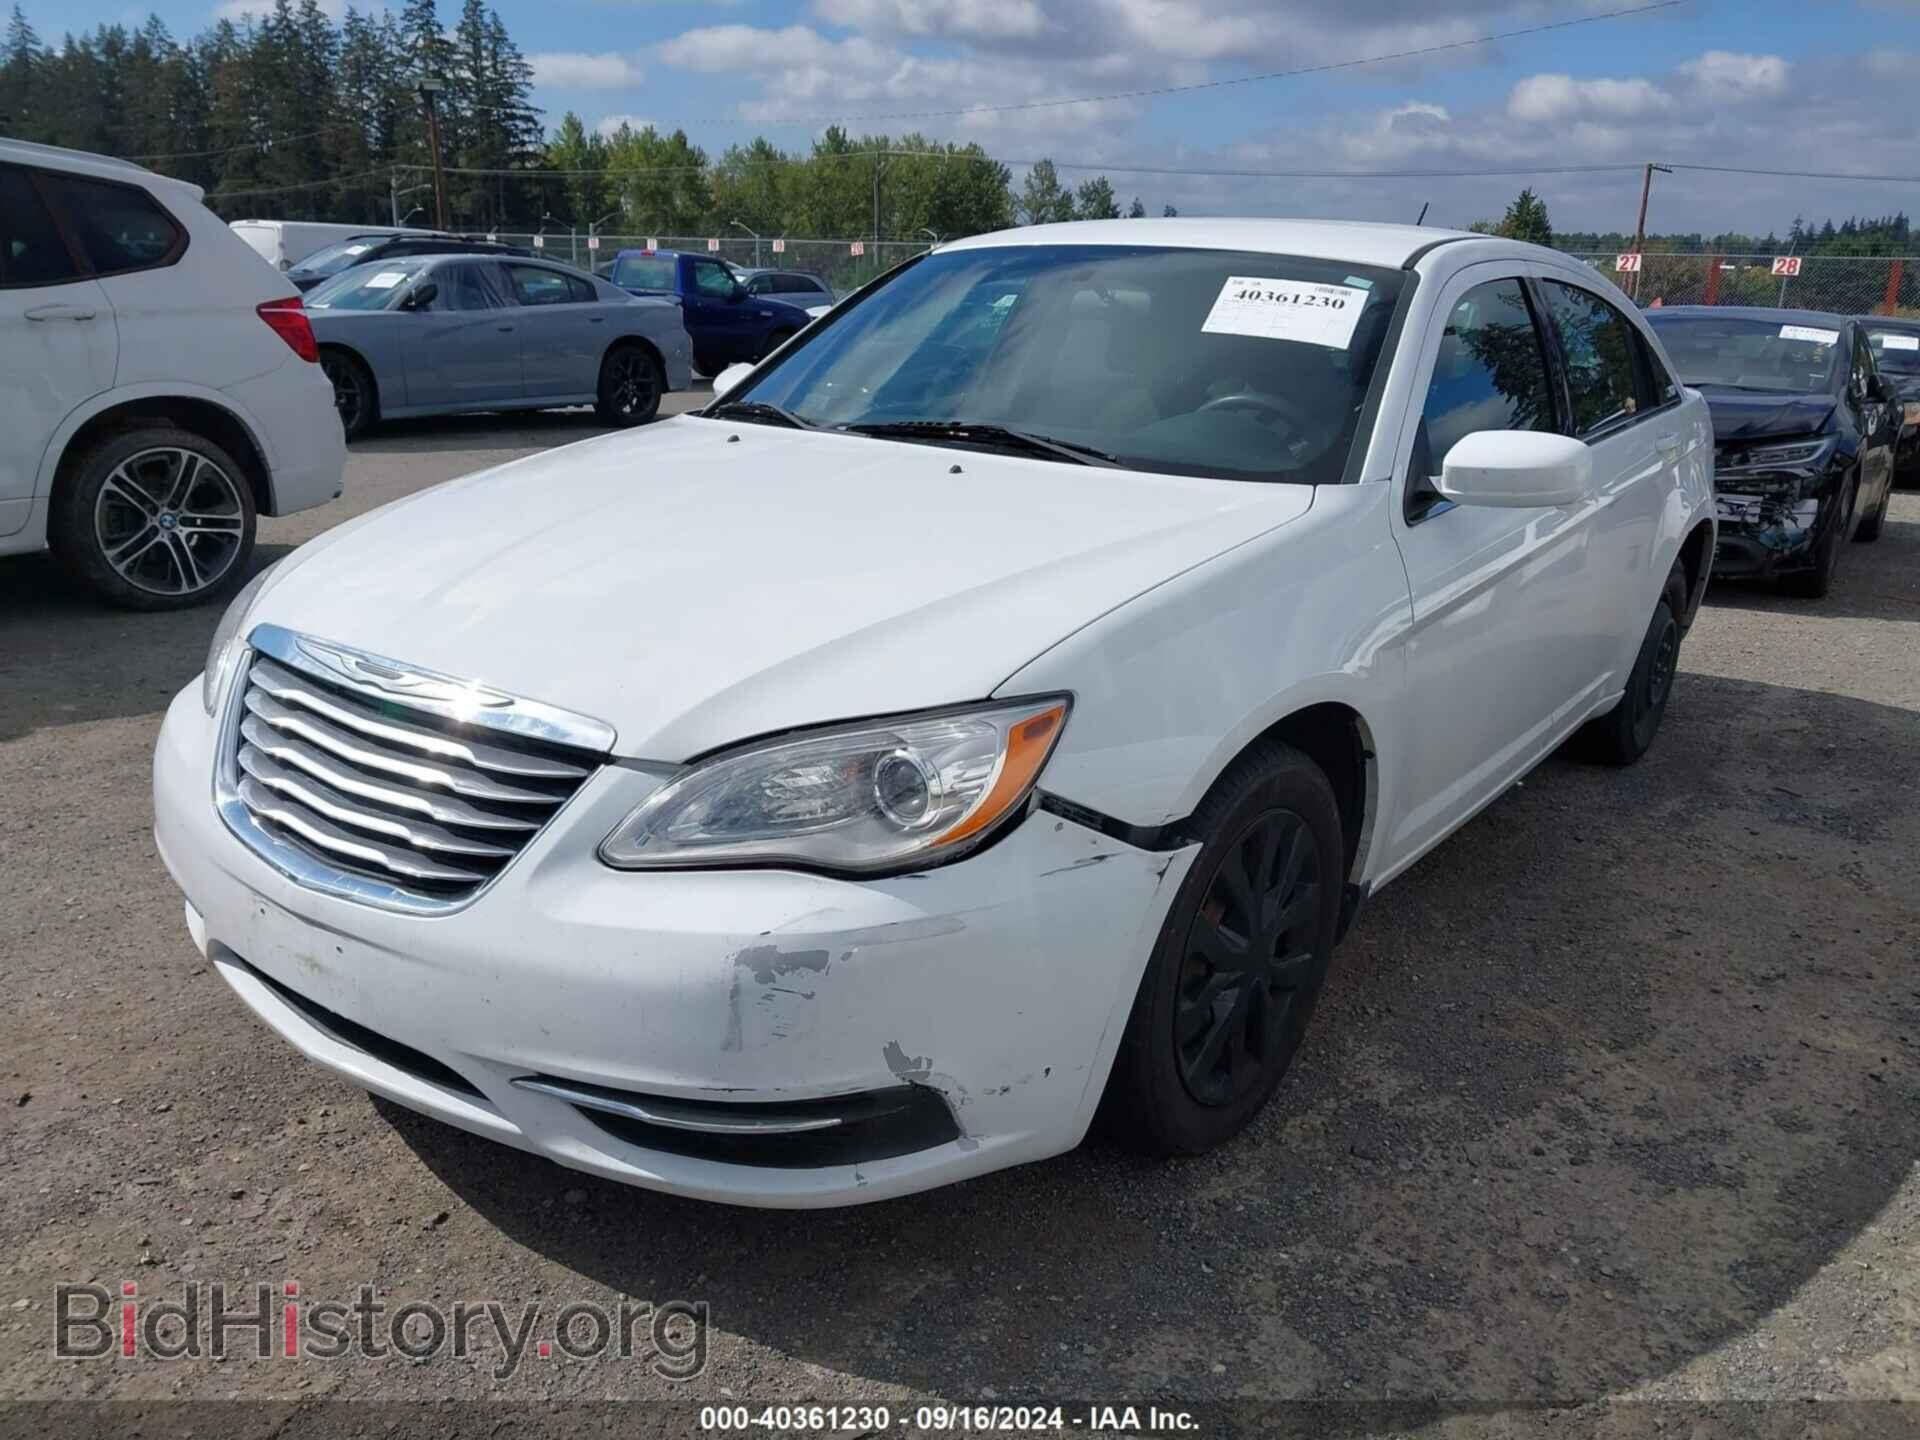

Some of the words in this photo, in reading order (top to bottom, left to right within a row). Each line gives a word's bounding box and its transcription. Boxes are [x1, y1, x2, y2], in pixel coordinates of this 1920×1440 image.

[1619, 255, 1639, 271] 27
[1775, 258, 1798, 275] 28
[1233, 288, 1346, 310] 40361230
